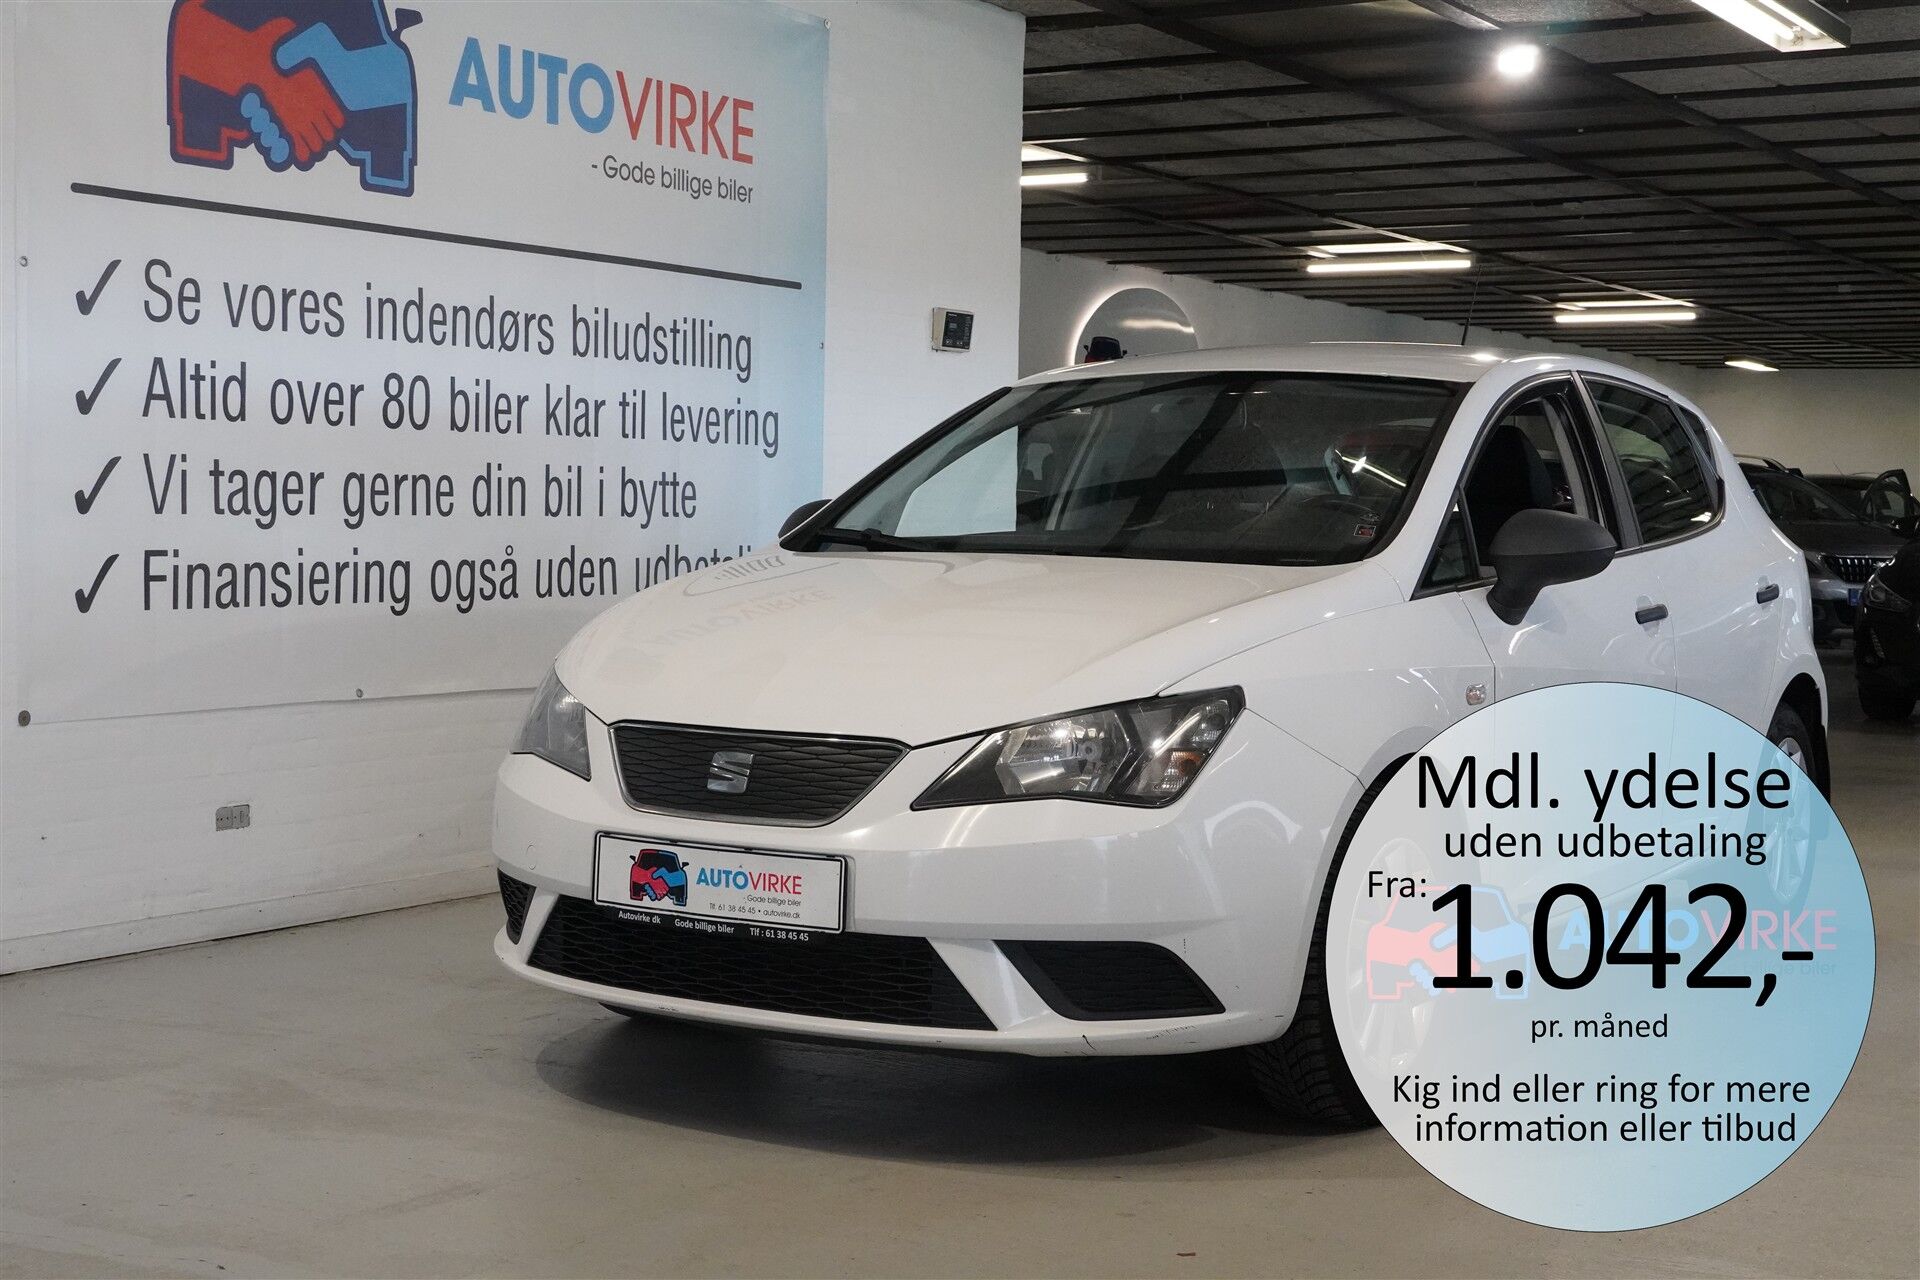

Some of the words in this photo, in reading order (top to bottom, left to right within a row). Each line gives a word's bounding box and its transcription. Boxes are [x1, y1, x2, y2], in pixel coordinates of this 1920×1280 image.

[449, 36, 754, 165] AUTOVIRKE
[603, 155, 655, 185] Gode
[661, 166, 713, 199] billige
[717, 177, 753, 203] biler
[144, 258, 201, 326] Se
[223, 281, 345, 338] vores
[366, 282, 554, 356] indendørs
[572, 303, 752, 383] biludstilling
[143, 356, 247, 422] Altid
[270, 378, 365, 427] over
[382, 372, 431, 431] 80
[450, 376, 529, 435] biler
[545, 383, 606, 439] klar
[618, 389, 646, 441] til
[662, 391, 779, 459] levering
[143, 453, 187, 515] Vi
[208, 458, 325, 530] tager
[343, 471, 454, 530] gerne
[472, 462, 526, 518] din
[544, 463, 582, 518] bil
[598, 467, 604, 517] i
[620, 466, 697, 530] bytte
[143, 548, 411, 617] Finansiering
[430, 544, 519, 615] også
[535, 544, 618, 599] uden
[696, 867, 802, 895] AUTOVIRKE
[618, 910, 651, 923] Autovirke
[718, 903, 726, 911] 61
[728, 904, 737, 913] 38
[738, 905, 747, 914] 45
[747, 906, 756, 915] 45
[747, 894, 766, 904] Gode
[767, 896, 787, 907] billige
[674, 918, 693, 929] Gode
[695, 921, 716, 933] billige
[717, 924, 735, 934] biler
[765, 929, 775, 938] 61
[776, 930, 786, 940] 38
[787, 931, 798, 941] 45
[798, 932, 809, 942] 45
